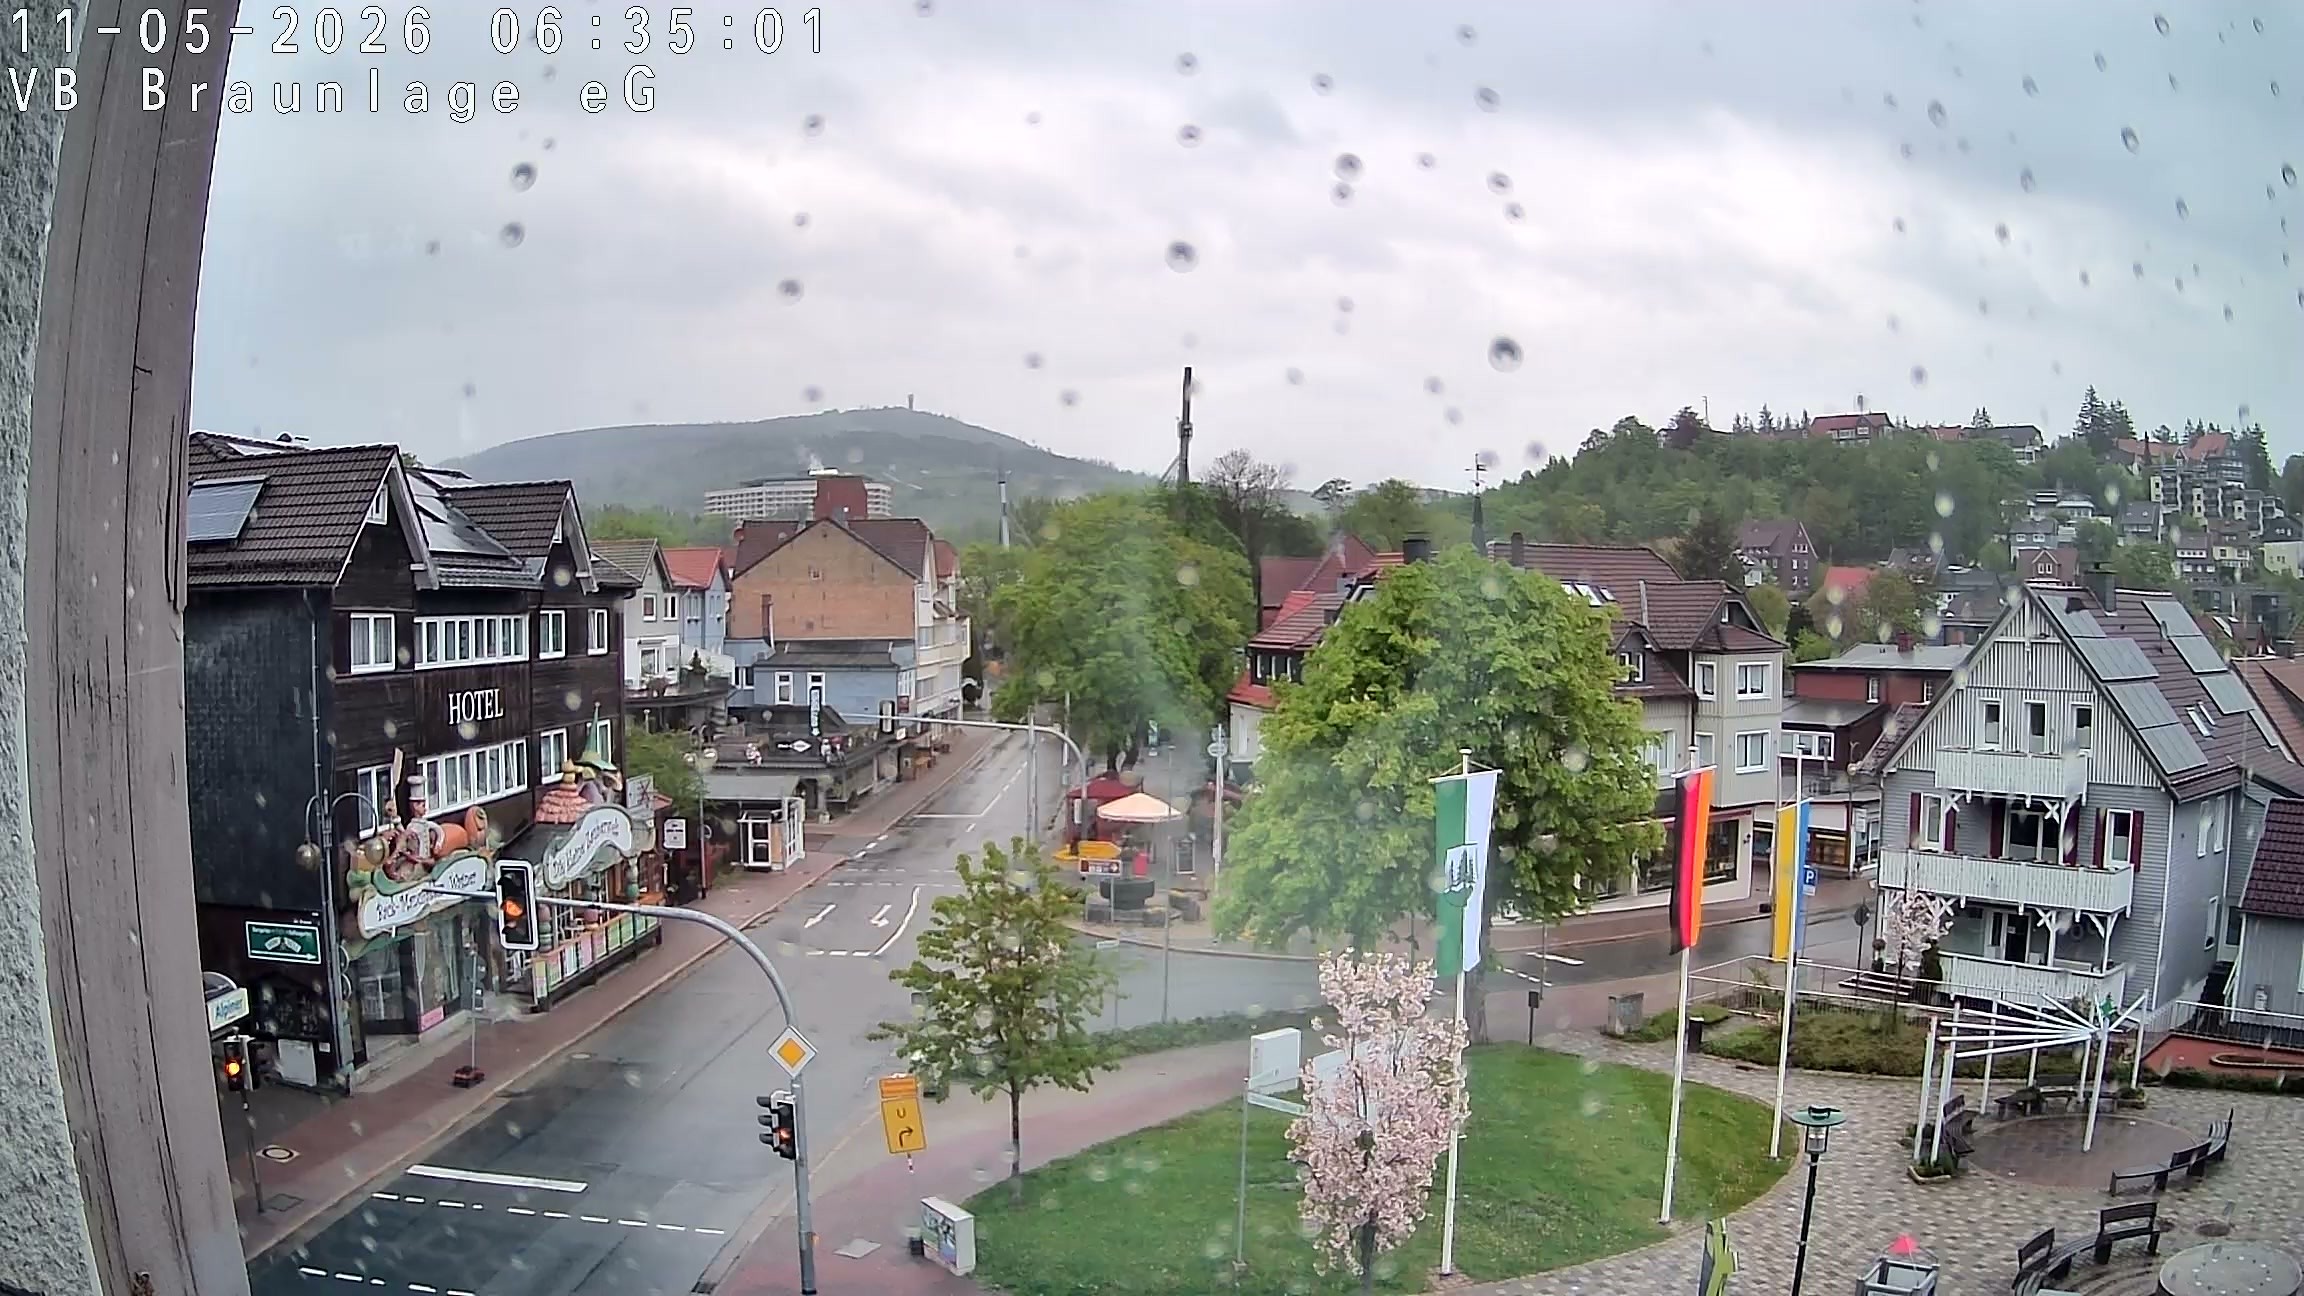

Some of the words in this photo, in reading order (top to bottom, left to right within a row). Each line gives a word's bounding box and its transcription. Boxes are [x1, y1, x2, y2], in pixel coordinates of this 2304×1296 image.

[448, 688, 504, 725] HOTEL
[1806, 870, 1815, 884] P
[896, 1107, 906, 1119] U
